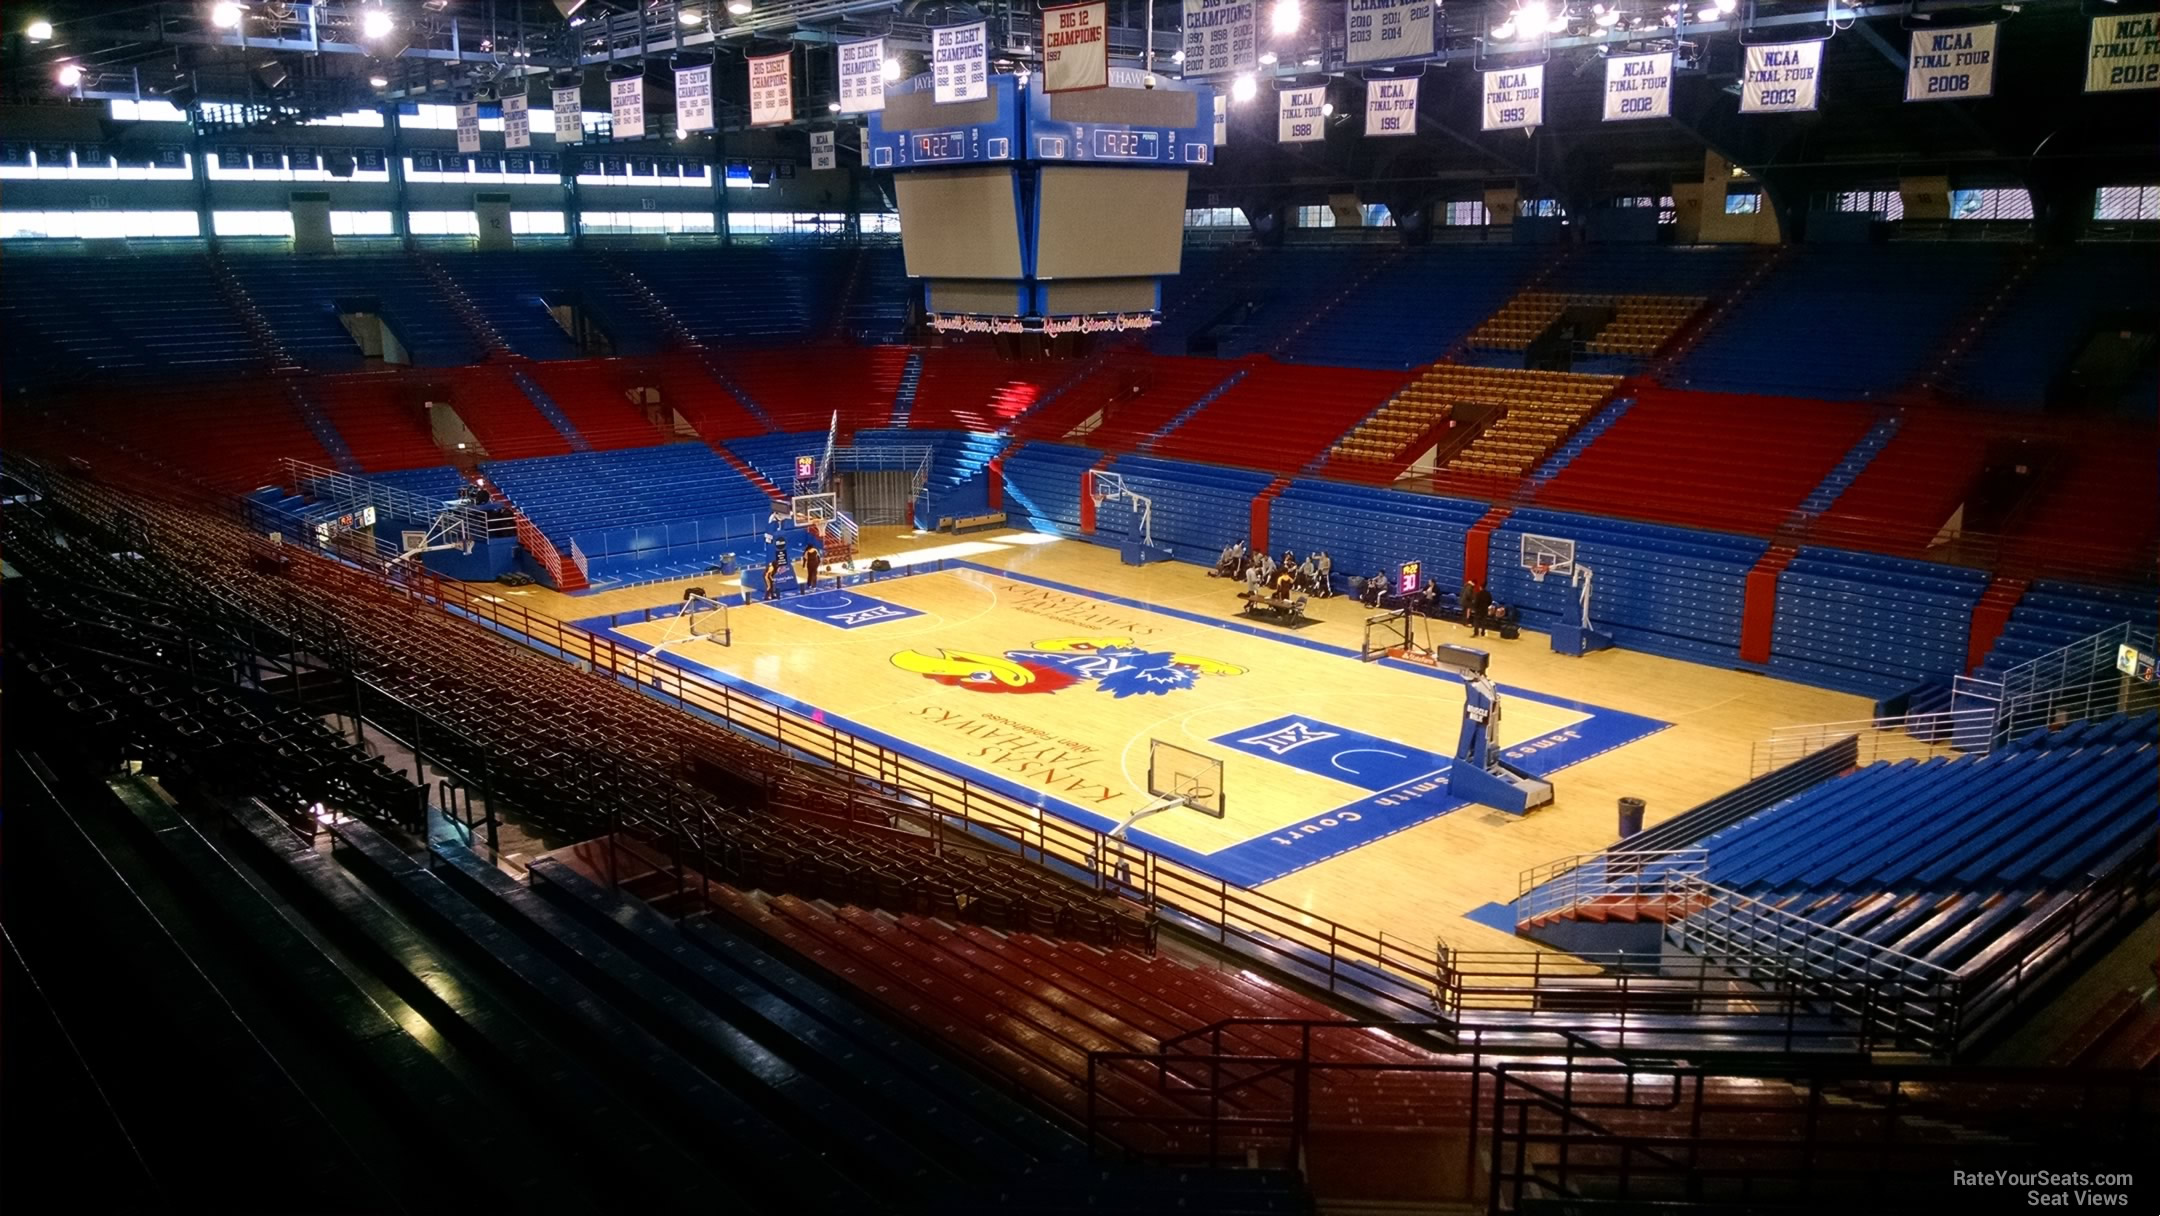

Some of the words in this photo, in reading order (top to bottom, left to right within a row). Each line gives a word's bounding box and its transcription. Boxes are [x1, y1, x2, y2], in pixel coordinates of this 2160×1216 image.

[1060, 13, 1076, 29] BIG
[1078, 10, 1089, 26] 12
[1186, 4, 1252, 28] CHAMPIONS
[1351, 15, 1372, 28] 2010
[1382, 12, 1400, 26] 2011
[1410, 6, 1430, 21] 2012
[938, 32, 952, 46] BIG
[955, 28, 979, 44] EIGHT
[1047, 26, 1102, 48] CHAMPIONS
[1187, 32, 1204, 44] 1997
[1210, 30, 1228, 42] 1998
[1350, 30, 1372, 43] 2013
[1382, 26, 1402, 40] 2014
[1932, 32, 1973, 52] NCAA
[844, 48, 856, 61] BIG
[858, 44, 878, 58] EIGHT
[936, 44, 984, 62] CHAMPIONS
[1186, 46, 1204, 58] 2003
[1210, 43, 1228, 56] 2005
[2092, 40, 2138, 59] FINAL
[2144, 37, 2160, 54] FO
[1046, 51, 1061, 62] 1997
[1764, 50, 1800, 66] NCAA
[1913, 55, 1951, 69] FINAL
[1956, 50, 1990, 67] FOUR
[754, 63, 764, 75] BIG
[766, 60, 785, 74] EIGHT
[842, 59, 881, 76] CHAMPIONS
[1186, 59, 1204, 72] 2007
[1623, 60, 1654, 77] NCAA
[2110, 63, 2160, 84] 2012
[680, 74, 688, 85] BIG
[690, 71, 708, 84] SEVEN
[752, 74, 788, 89] CHAMPIONS
[1498, 73, 1527, 88] NCAA
[1748, 70, 1781, 82] FINAL
[1785, 68, 1814, 80] FOUR
[618, 84, 626, 95] BIG
[678, 84, 709, 98] CHAMPIONS
[914, 76, 934, 92] JAYH
[1380, 84, 1404, 98] NCAA
[1609, 79, 1638, 92] FINAL
[1642, 76, 1668, 90] FOUR
[1928, 74, 1970, 93] 2008
[613, 94, 640, 108] CHAMPIONS
[1291, 93, 1313, 106] NCAA
[1487, 92, 1513, 104] FINAL
[1516, 88, 1540, 100] FOUR
[1760, 89, 1796, 106] 2003
[555, 102, 580, 114] CHAMPIONS
[1282, 109, 1302, 120] FINAL
[1304, 106, 1322, 118] FOUR
[1370, 100, 1392, 112] FINAL
[1394, 98, 1414, 110] FOUR
[1621, 97, 1652, 113] 2002
[1500, 108, 1525, 122] 1993
[1292, 124, 1312, 137] 1988
[1380, 117, 1400, 130] 1991
[1104, 134, 1138, 155] 19:22
[296, 154, 310, 164] 32
[490, 218, 500, 229] 12
[934, 314, 962, 334] Russell
[962, 316, 990, 333] Stover
[990, 316, 1024, 334] Candies
[1042, 316, 1080, 338] Russell
[1081, 315, 1116, 334] Stover
[1116, 312, 1152, 332] Candies
[799, 464, 811, 476] 30
[1403, 574, 1416, 592] 30
[1000, 584, 1106, 610] KANSAS
[1010, 598, 1163, 635] JAYHAWKS
[1058, 652, 1144, 676] KU
[1468, 704, 1488, 717] MUSCLE
[981, 712, 1058, 742] Fieldhouse
[910, 706, 1105, 771] JAYHAWKS
[1057, 738, 1100, 754] Allen
[966, 746, 1127, 804] KANSAS
[1270, 812, 1362, 846] Court
